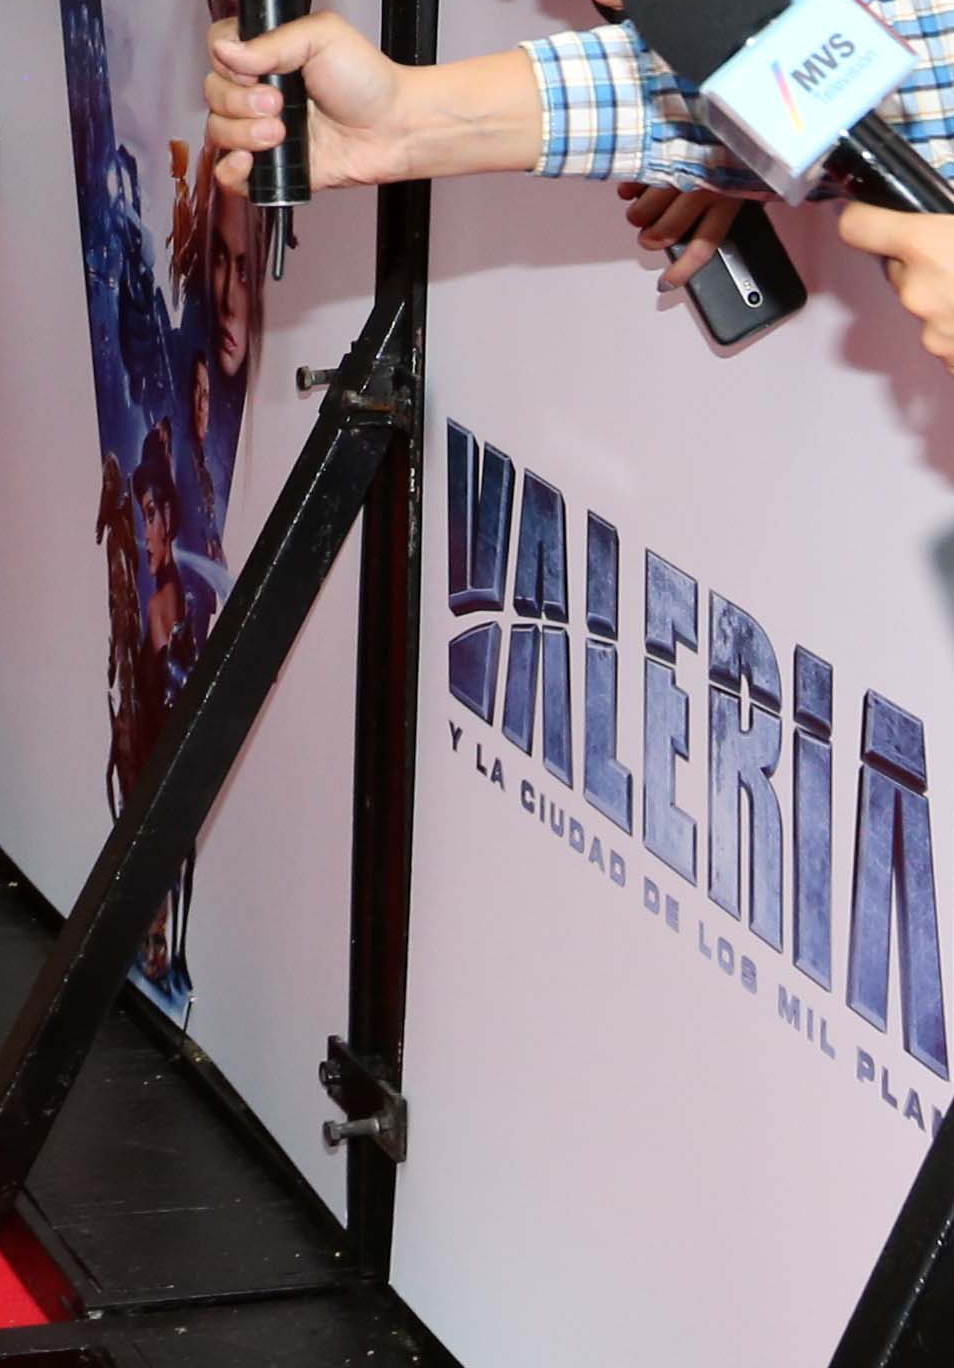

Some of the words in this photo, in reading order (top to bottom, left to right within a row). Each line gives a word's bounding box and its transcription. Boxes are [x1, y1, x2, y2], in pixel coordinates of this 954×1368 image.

[790, 33, 856, 92] MVS
[448, 720, 464, 752] Y
[476, 743, 505, 792] LA
[520, 779, 626, 888] CIUDAD
[644, 875, 680, 934] DE
[698, 919, 758, 995] LOS
[777, 983, 836, 1060] MIL
